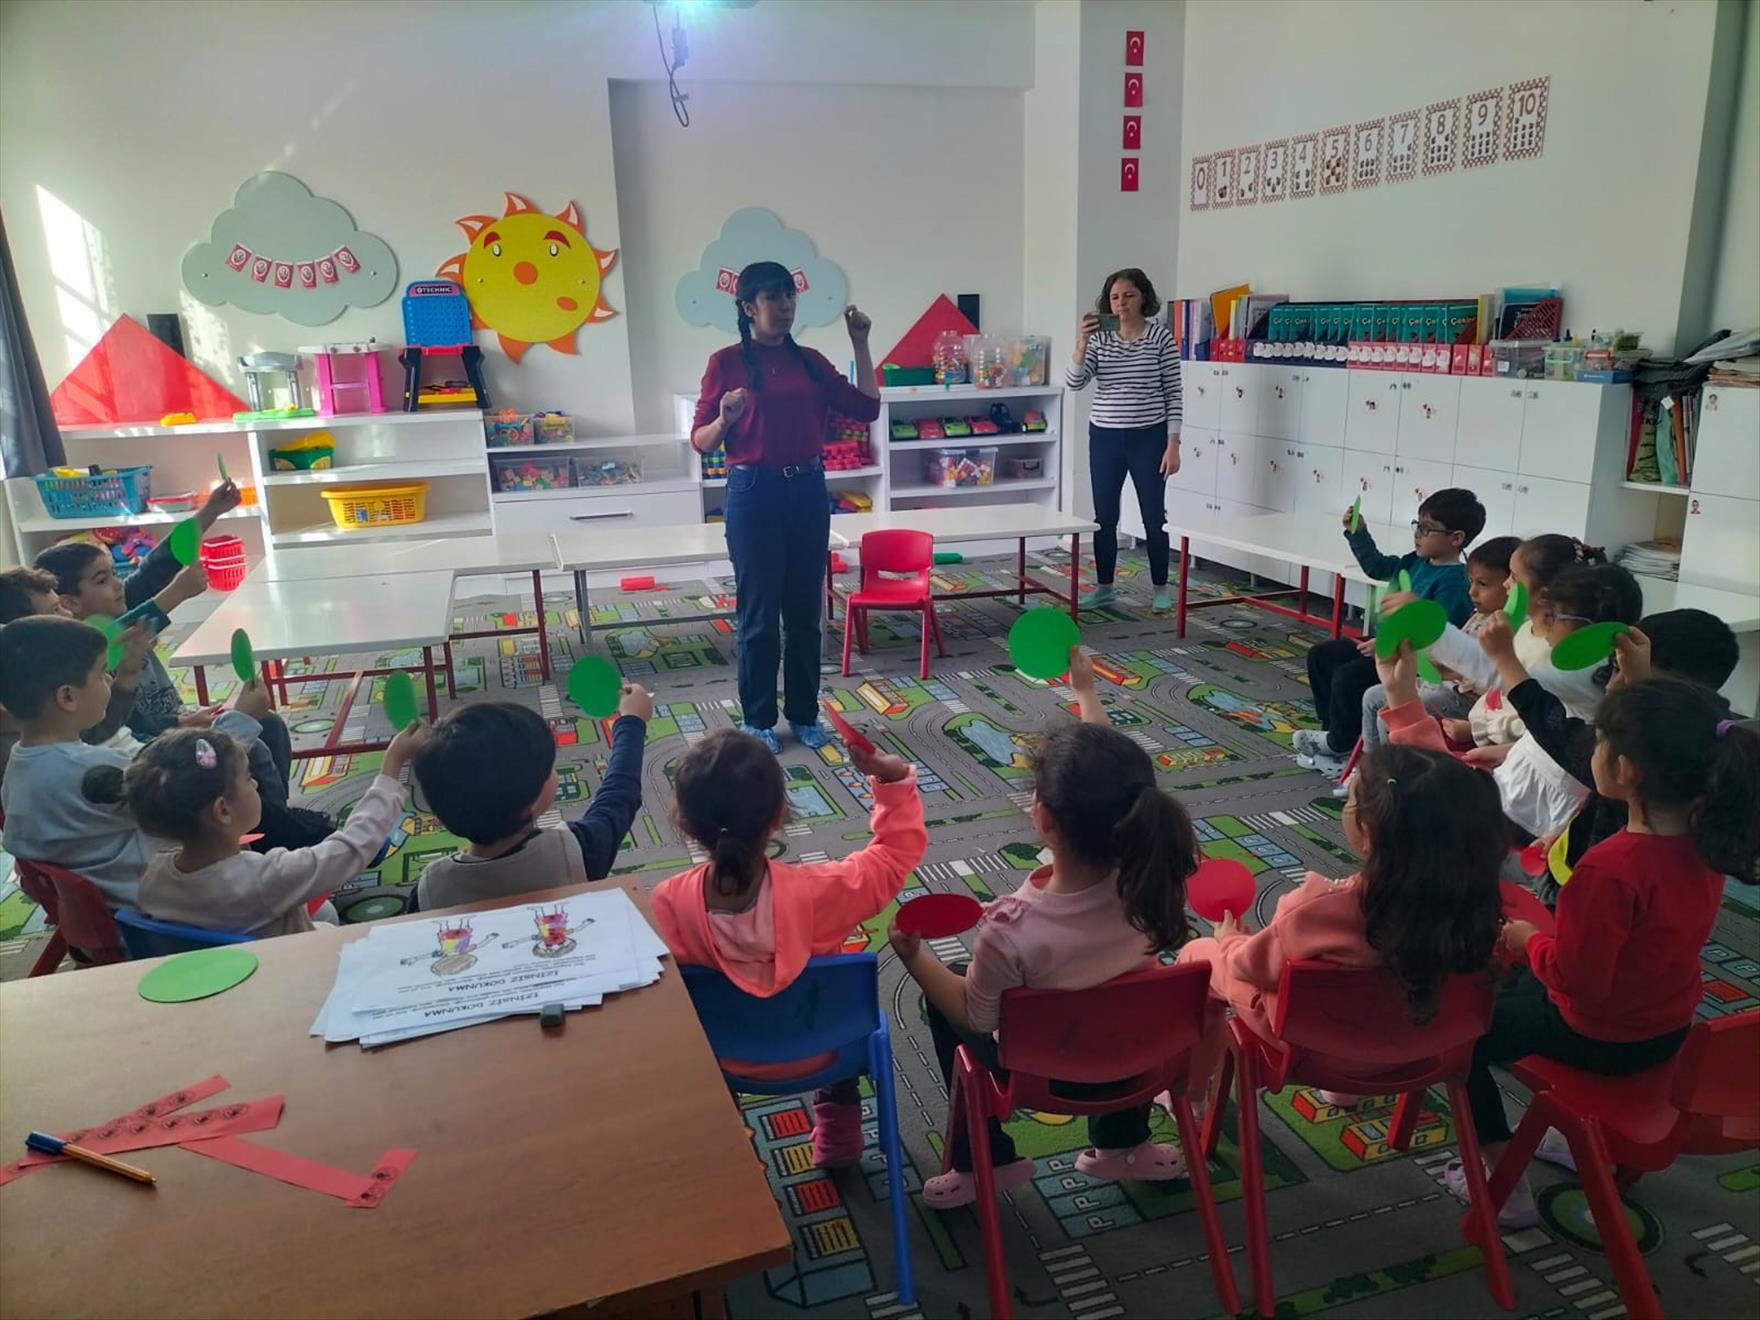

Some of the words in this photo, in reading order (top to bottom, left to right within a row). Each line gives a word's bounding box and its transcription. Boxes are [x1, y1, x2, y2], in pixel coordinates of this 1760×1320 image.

[1518, 92, 1536, 117] 10
[1478, 103, 1488, 126] 9
[1400, 123, 1409, 144] 7
[1436, 114, 1446, 135] 8
[1330, 138, 1340, 159] 5
[1364, 133, 1373, 152] 6
[1270, 150, 1279, 170] 3
[1299, 144, 1307, 164] 4
[1221, 160, 1228, 177] 1
[1243, 156, 1252, 174] 2
[1196, 167, 1206, 191] 0
[448, 979, 506, 992] DOKUNMA
[424, 1002, 484, 1017] DOKUNMA
[1047, 1160, 1075, 1172] P
[1061, 1177, 1088, 1190] P
[1074, 1195, 1101, 1210] P
[1087, 1215, 1114, 1230] P
